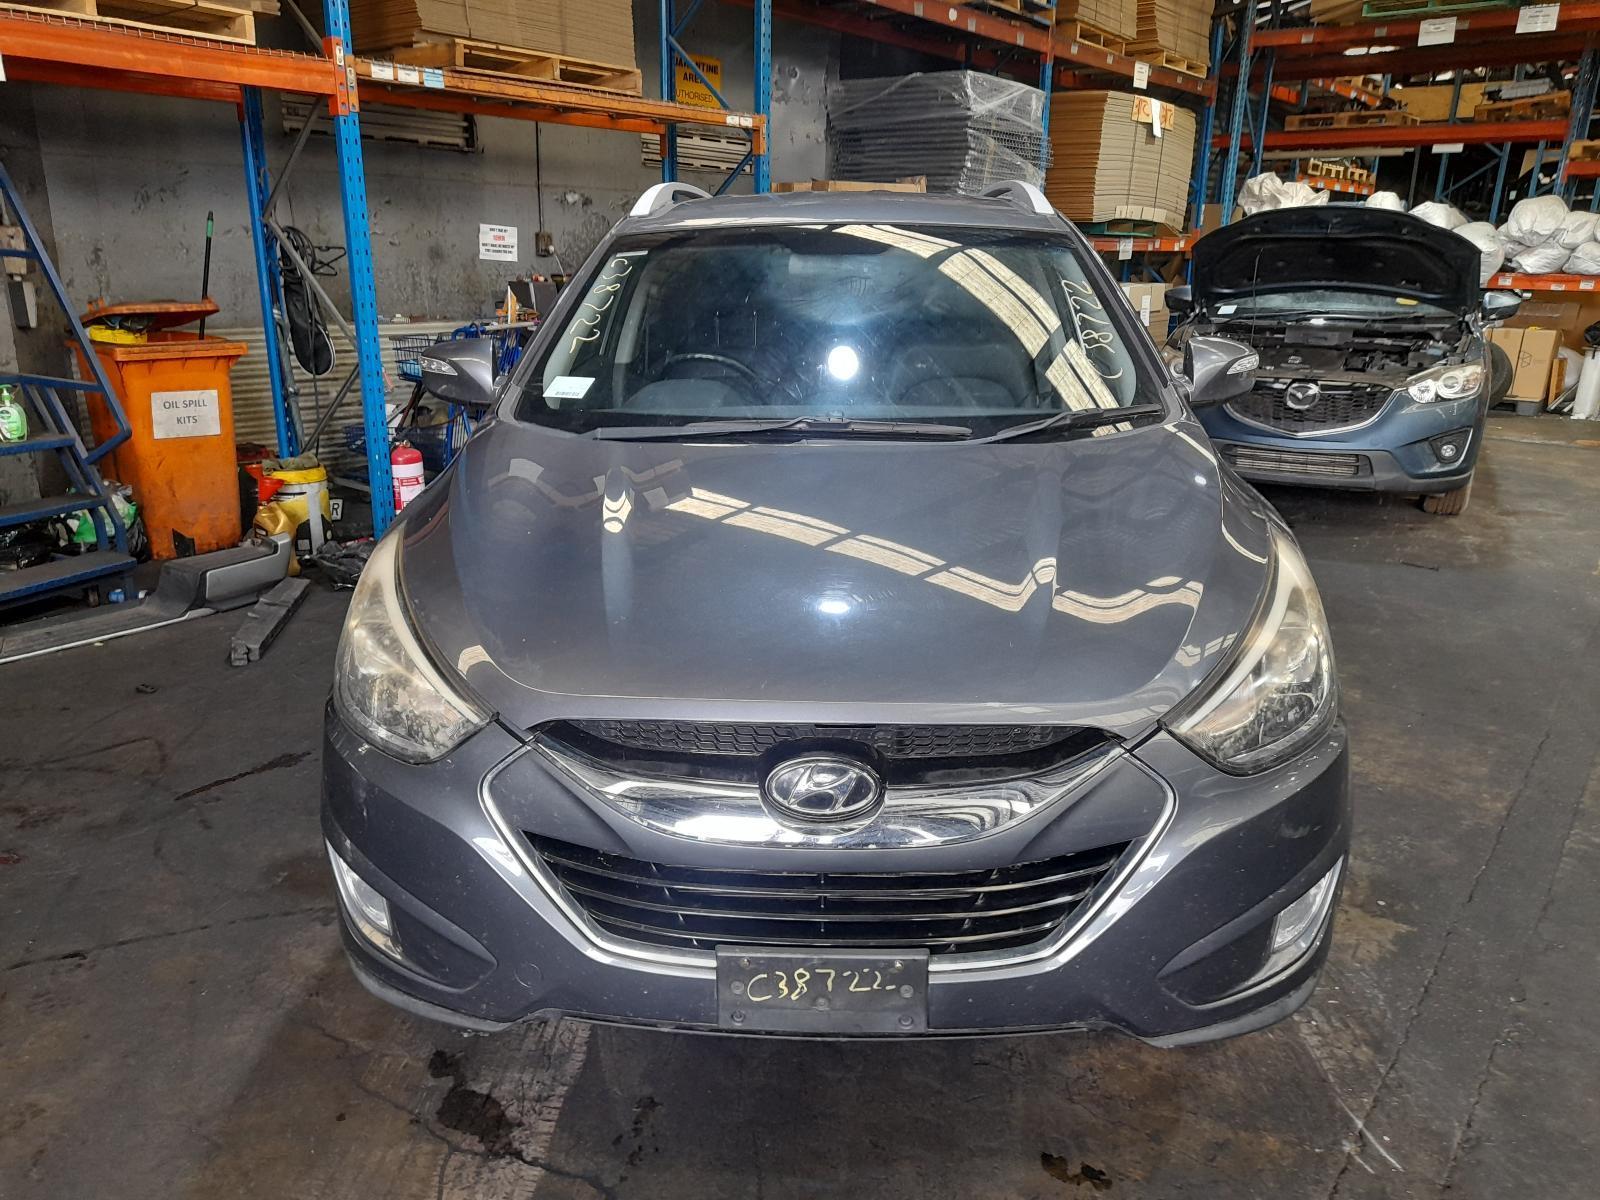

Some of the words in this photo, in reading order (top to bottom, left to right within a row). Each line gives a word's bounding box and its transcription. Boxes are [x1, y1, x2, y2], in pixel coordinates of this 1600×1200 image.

[683, 72, 702, 84] ARE
[675, 88, 713, 103] UTHORISED
[163, 401, 180, 409] OIL
[182, 399, 208, 408] SPILL
[176, 416, 198, 424] KITS
[746, 968, 896, 1002] C38722
